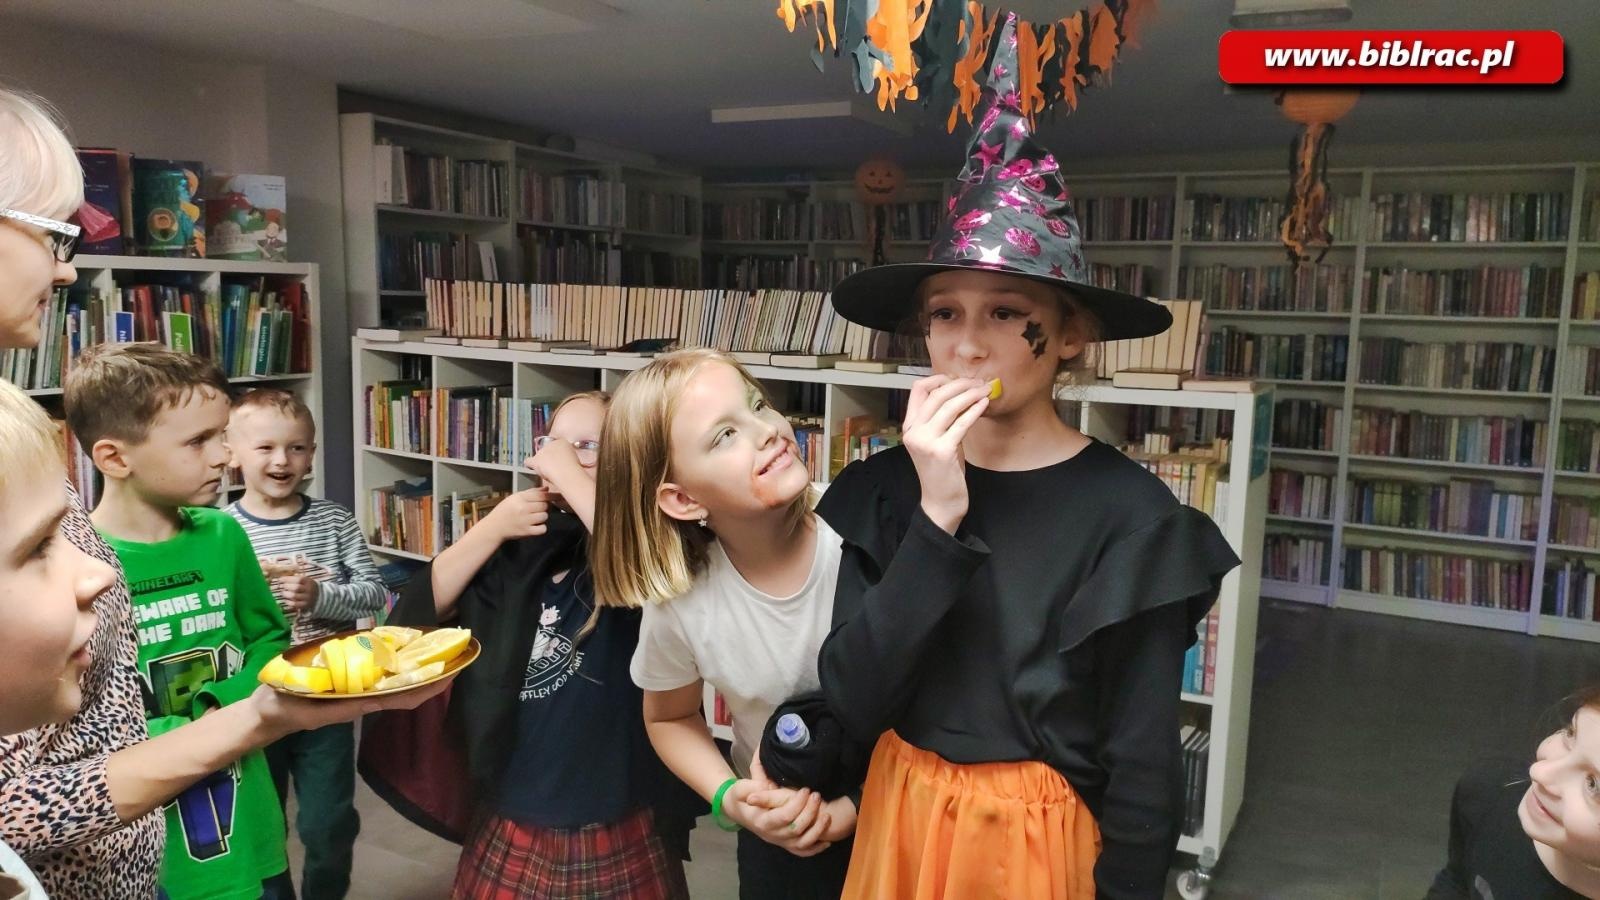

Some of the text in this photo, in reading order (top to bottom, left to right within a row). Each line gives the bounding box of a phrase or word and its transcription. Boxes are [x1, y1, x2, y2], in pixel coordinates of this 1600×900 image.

[206, 588, 229, 607] OF
[138, 610, 227, 647] HE DARK
[519, 686, 551, 702] AFFLEY
